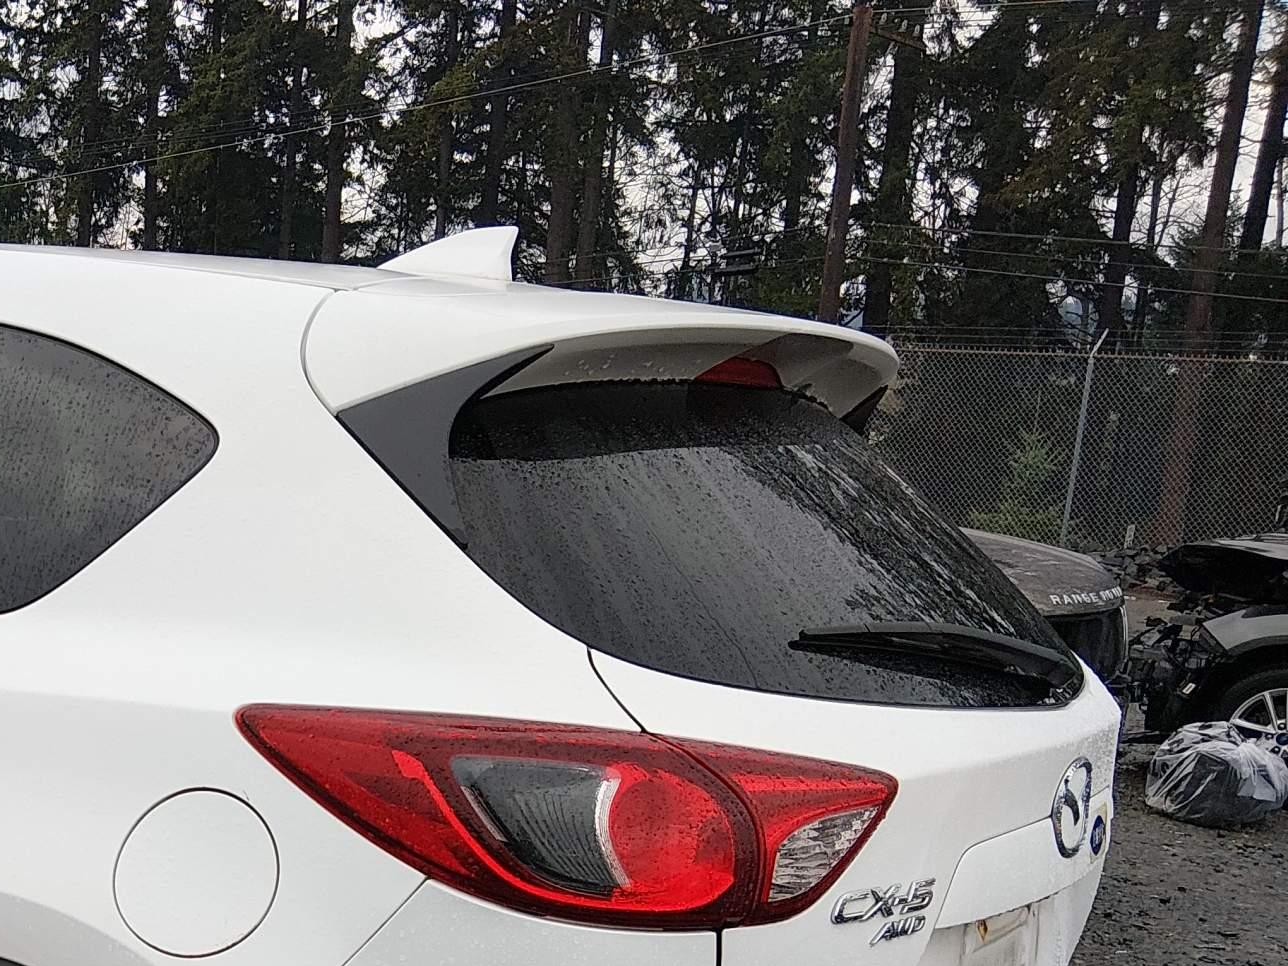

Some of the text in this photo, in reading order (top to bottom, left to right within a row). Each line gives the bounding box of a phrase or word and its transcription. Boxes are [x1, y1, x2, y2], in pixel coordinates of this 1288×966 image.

[1049, 592, 1099, 605] RANGE
[830, 877, 936, 925] CX-5
[869, 915, 926, 947] AWD
